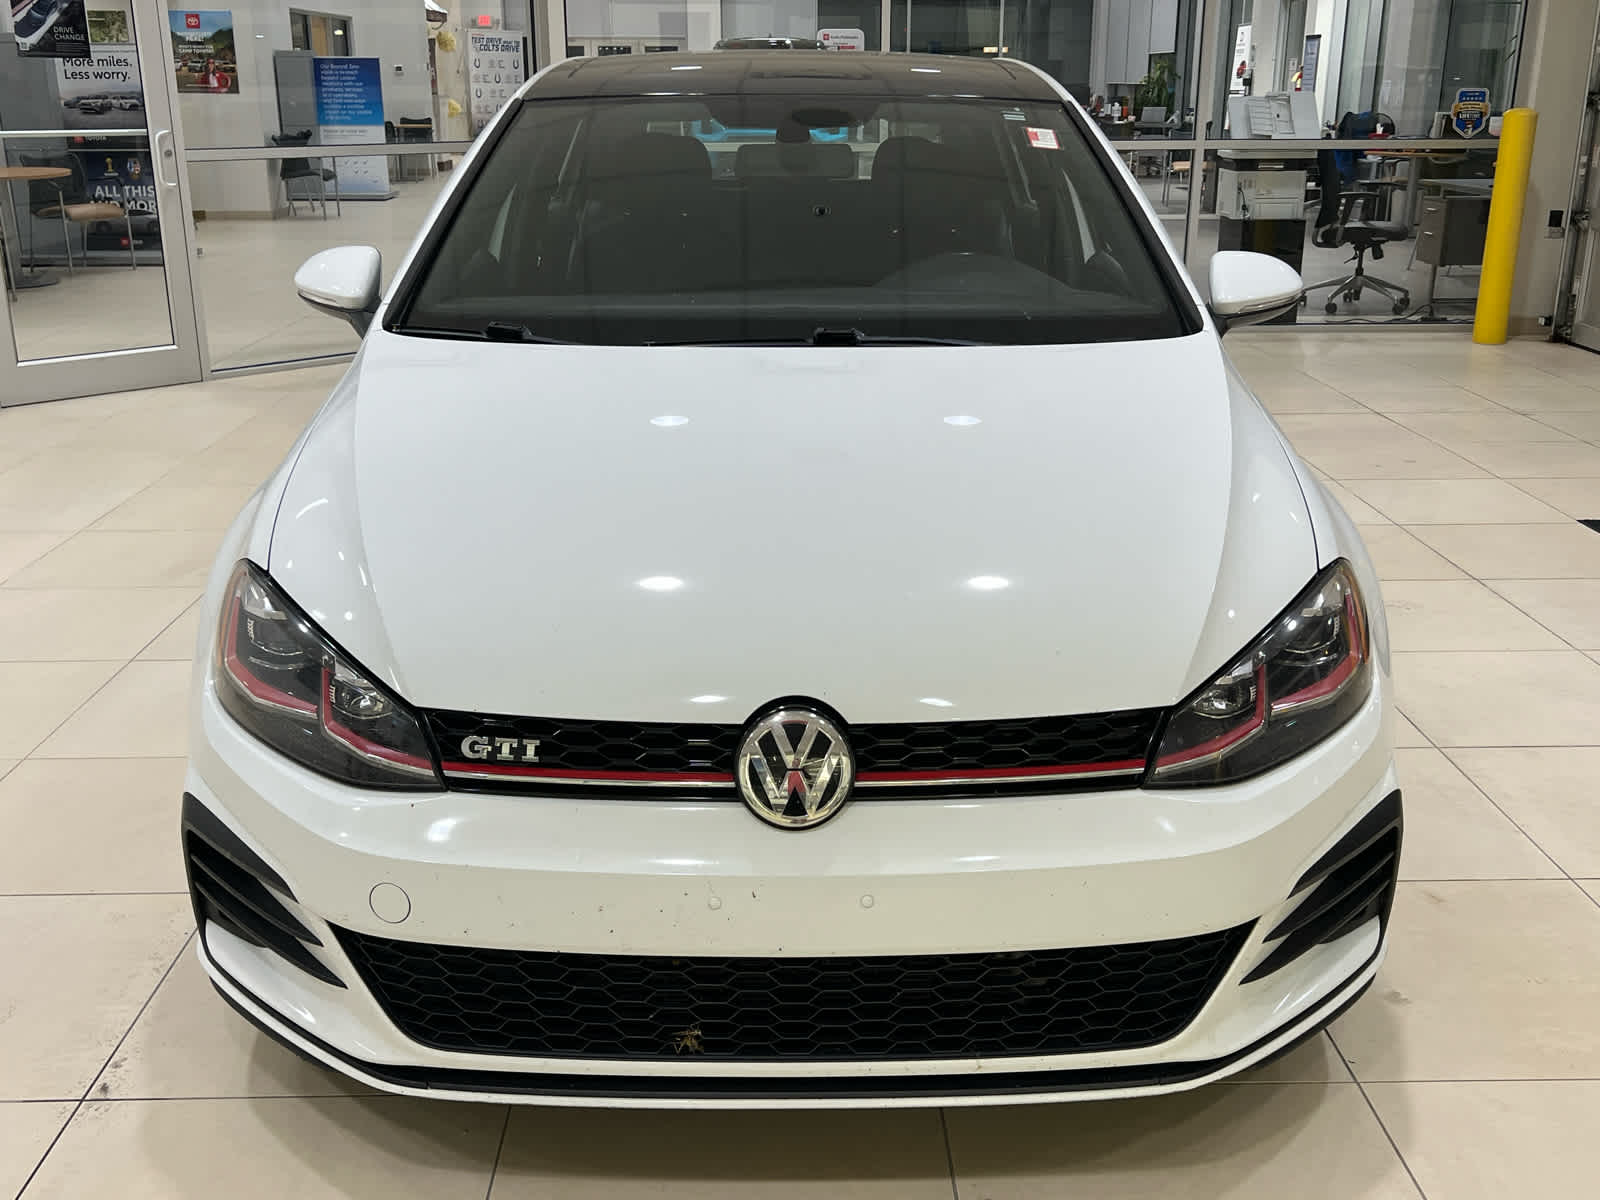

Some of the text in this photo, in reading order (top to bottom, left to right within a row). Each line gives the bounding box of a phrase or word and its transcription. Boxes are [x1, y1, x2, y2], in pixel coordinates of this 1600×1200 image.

[53, 26, 74, 34] DRIVE
[54, 33, 86, 41] CHANGE
[480, 44, 521, 53] COLTS DRIVE
[62, 56, 133, 67] More miles.
[64, 69, 131, 82] Less worry.
[95, 185, 155, 198] ALL THIS
[126, 200, 157, 213] MOR
[460, 735, 540, 763] GTI
